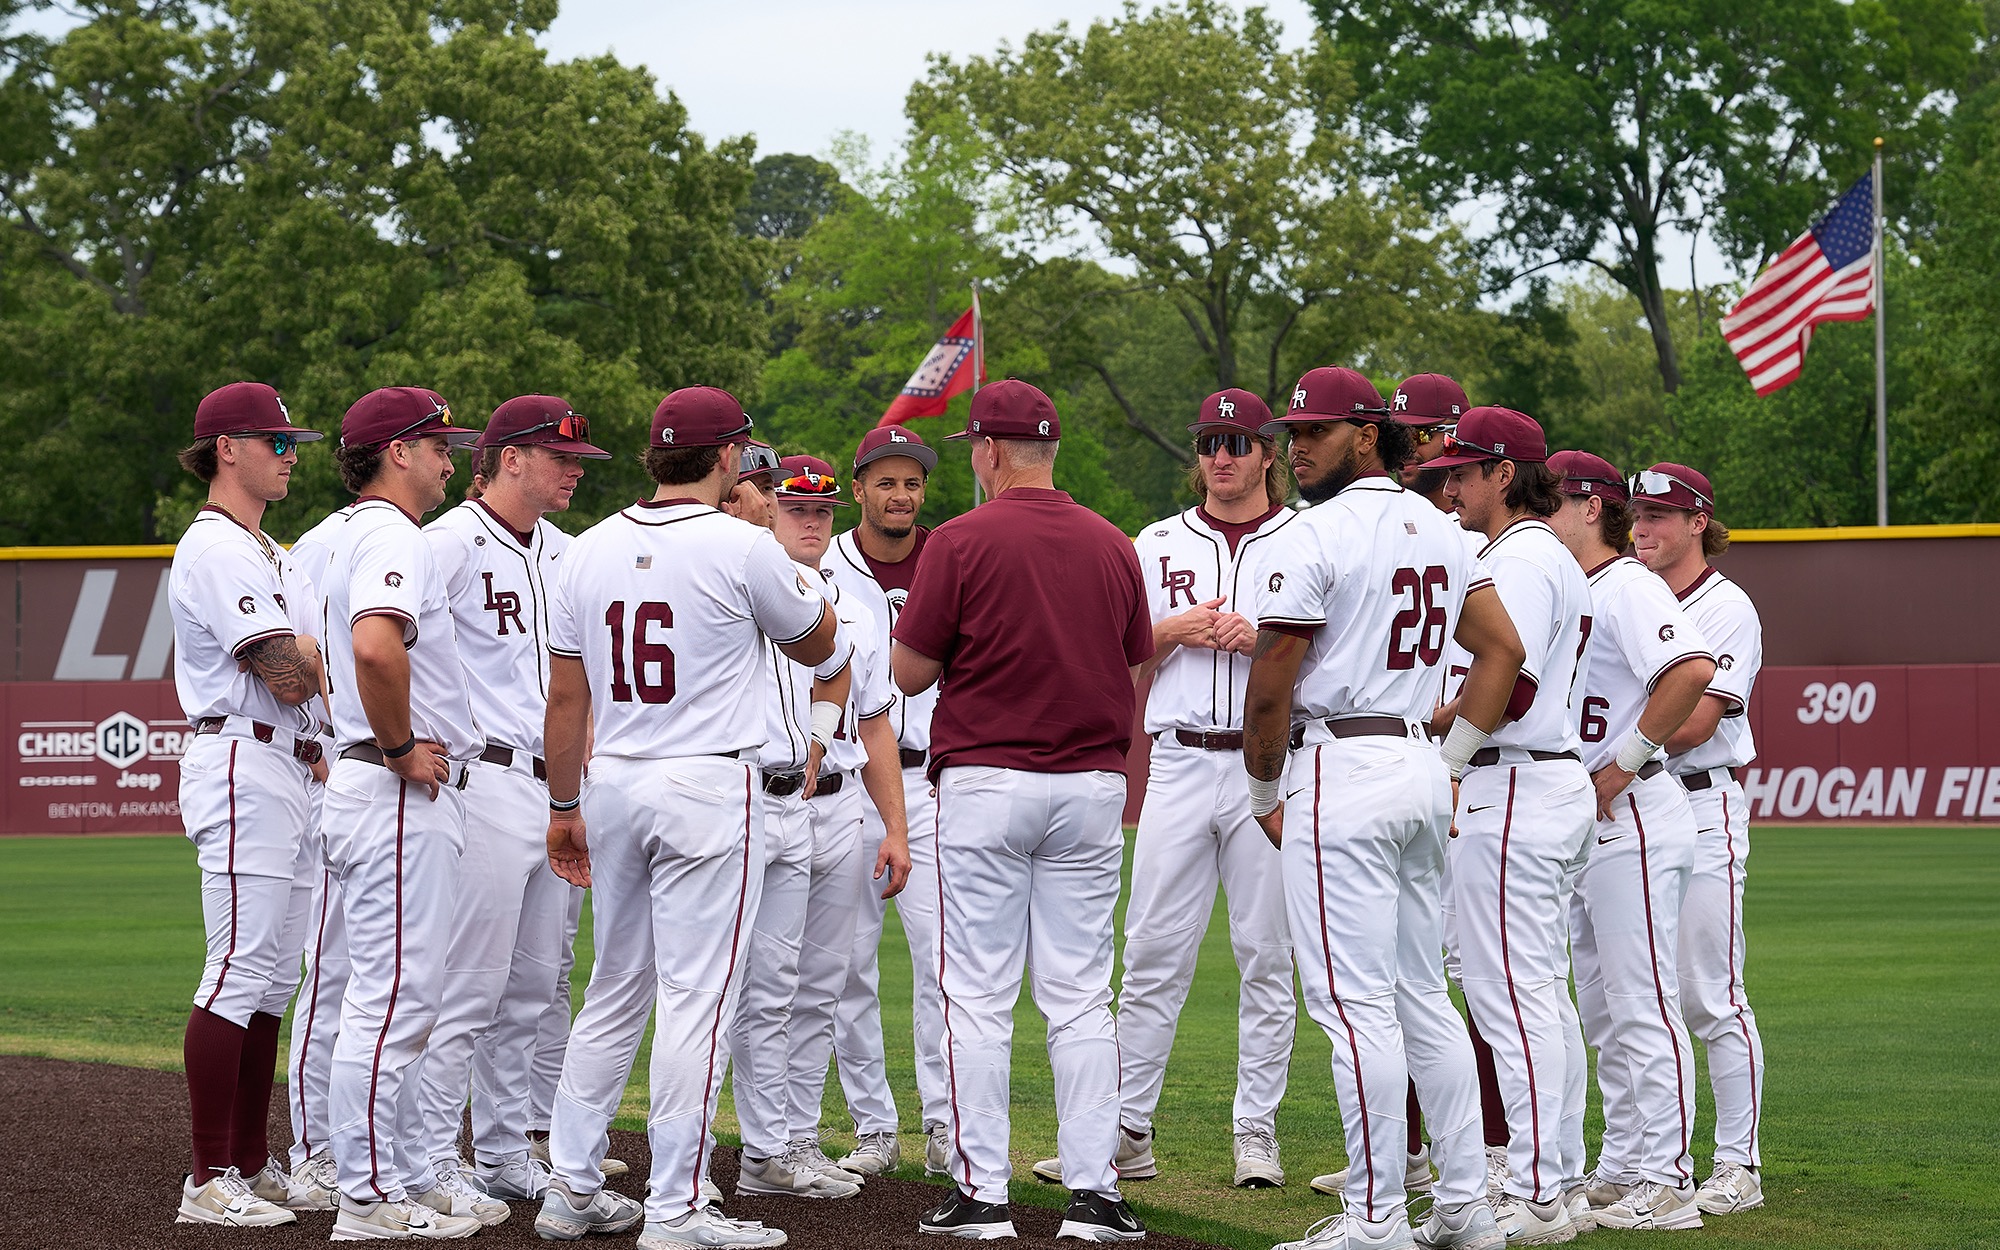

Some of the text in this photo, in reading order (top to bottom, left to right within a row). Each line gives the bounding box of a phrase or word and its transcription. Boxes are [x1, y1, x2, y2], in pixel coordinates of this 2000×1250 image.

[1217, 396, 1236, 418] LR
[481, 571, 527, 636] LR
[1159, 555, 1198, 609] LR
[1386, 564, 1449, 670] 26
[605, 600, 677, 705] 16
[1796, 681, 1877, 725] 390
[18, 731, 96, 757] CHRIS
[116, 769, 162, 791] Jeep
[1743, 765, 1927, 818] HOGAN
[48, 801, 117, 819] BENTON,
